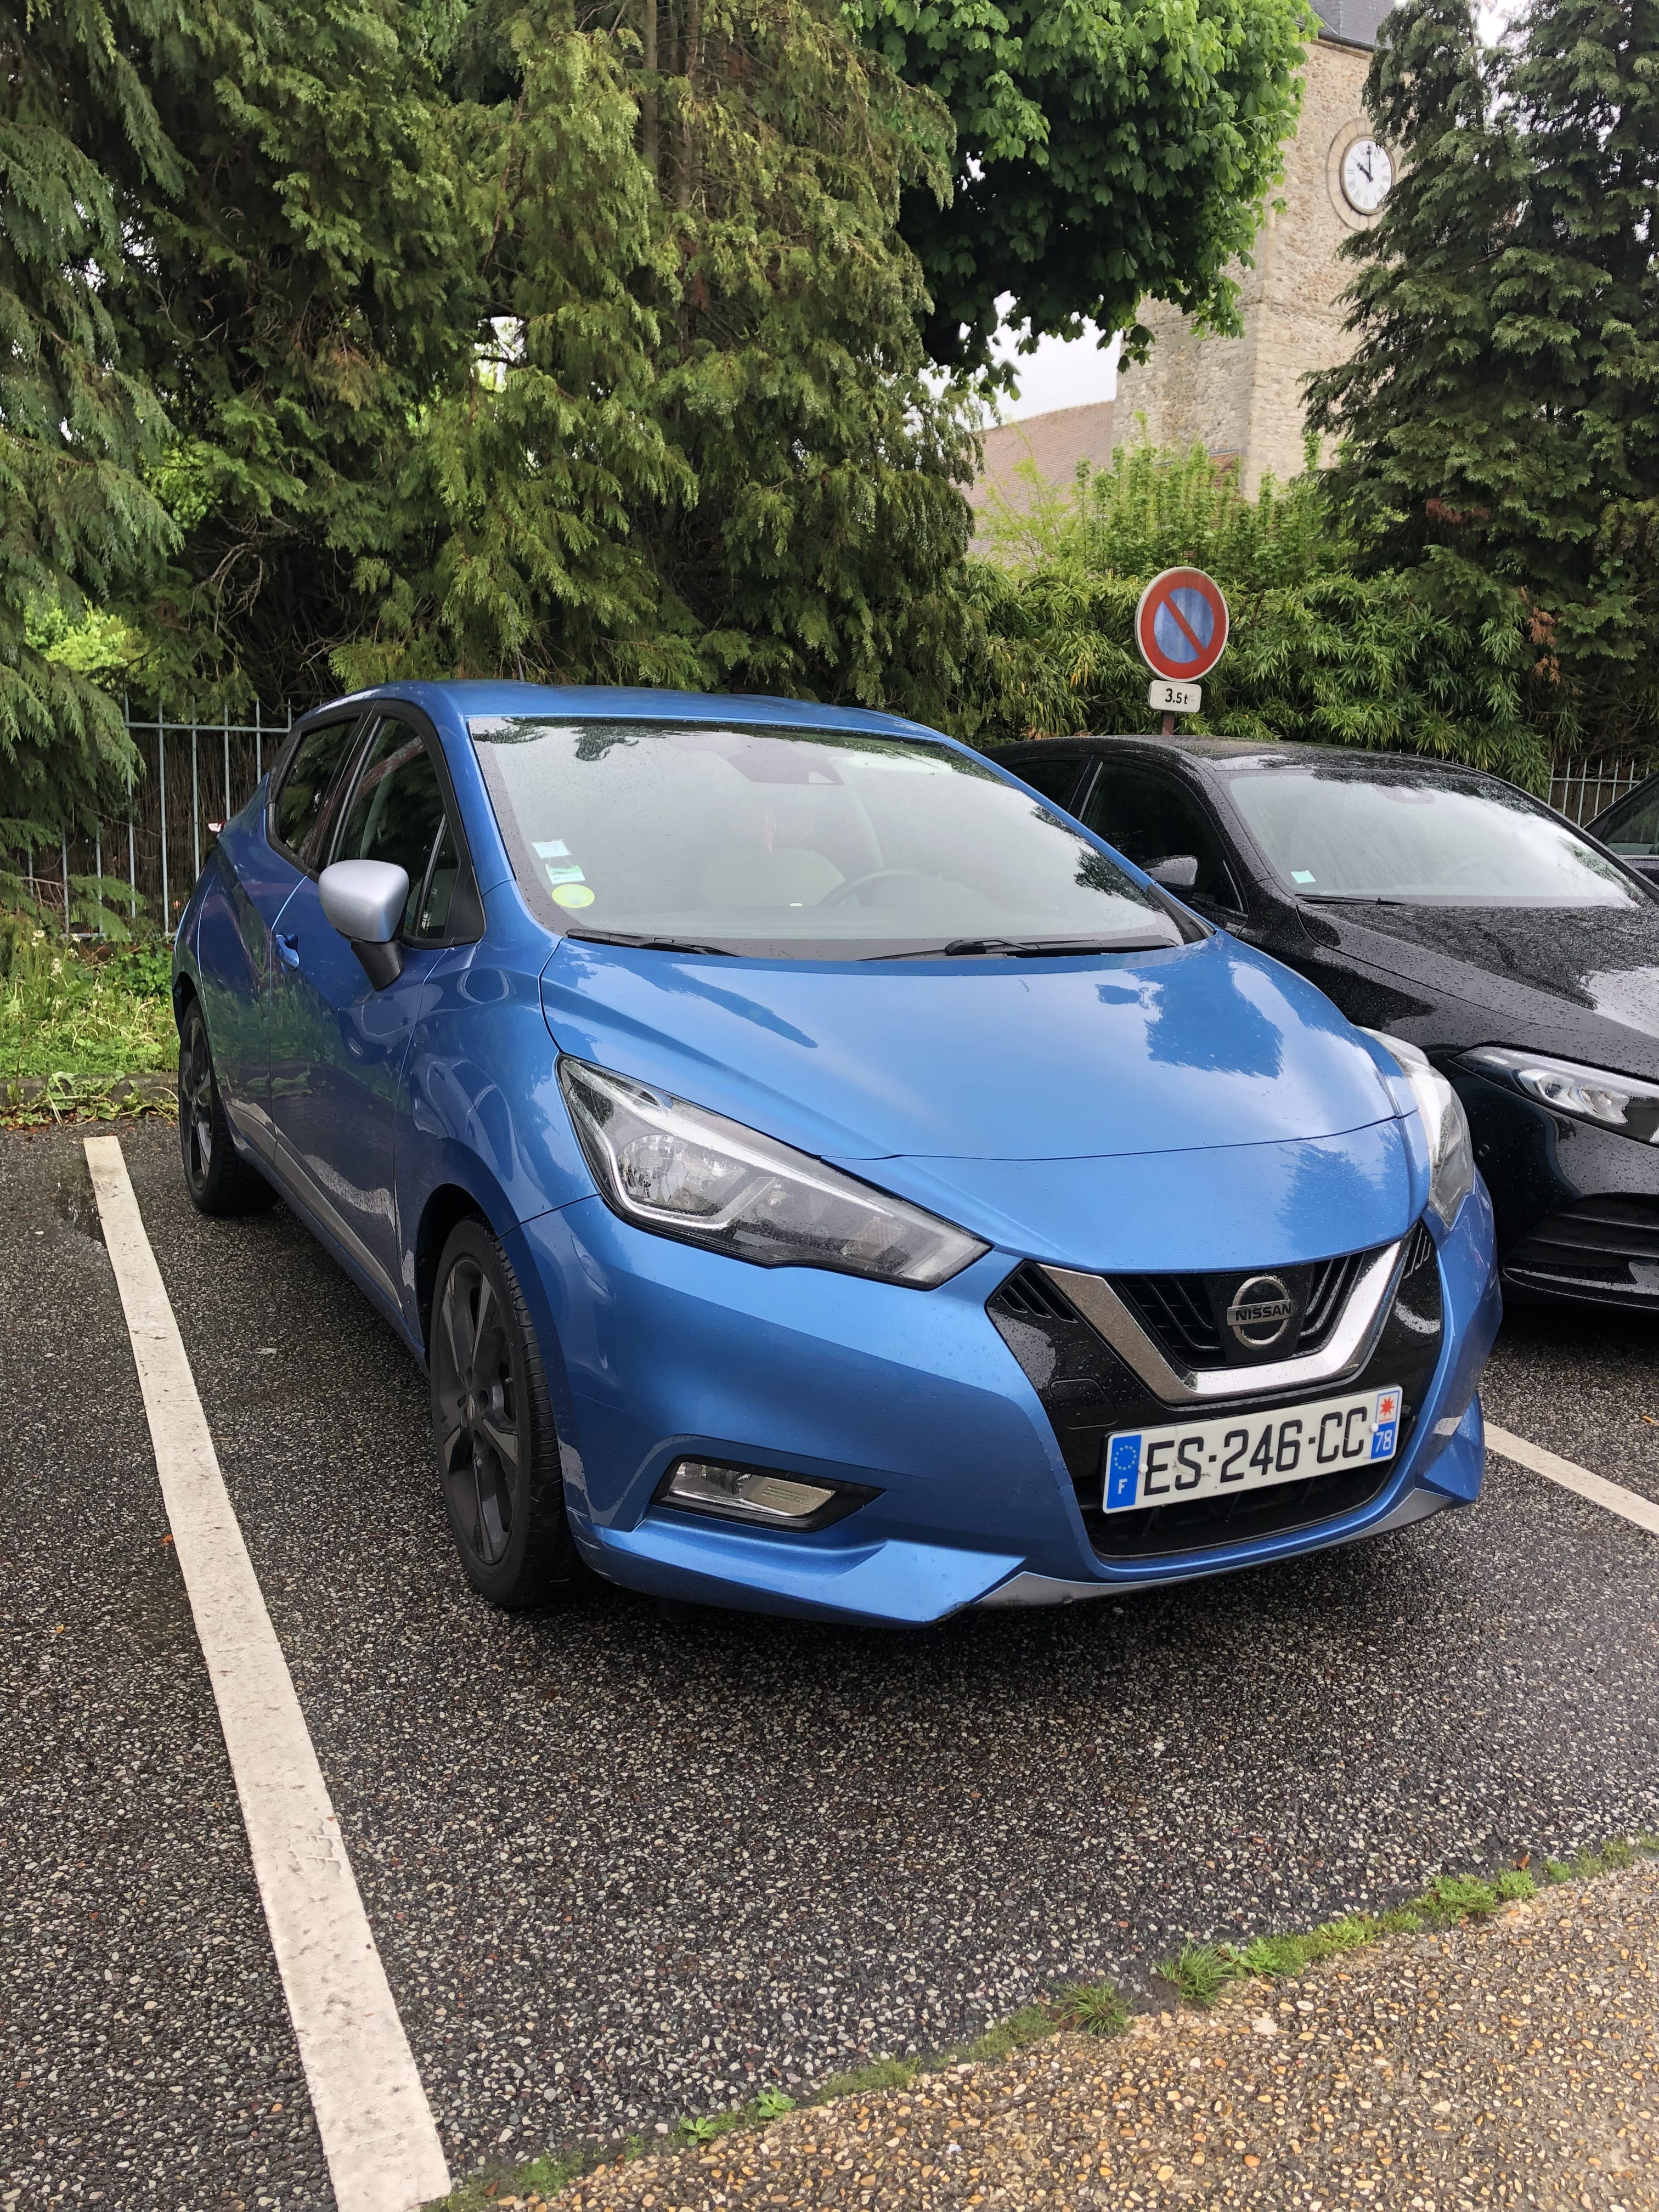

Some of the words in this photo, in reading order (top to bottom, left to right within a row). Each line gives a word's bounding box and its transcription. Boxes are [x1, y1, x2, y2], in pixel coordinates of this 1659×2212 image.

[1235, 1303, 1291, 1321] NISSAN
[1143, 1406, 1368, 1496] ES-246-CC
[1375, 1429, 1393, 1453] 78
[1118, 1477, 1128, 1495] F
